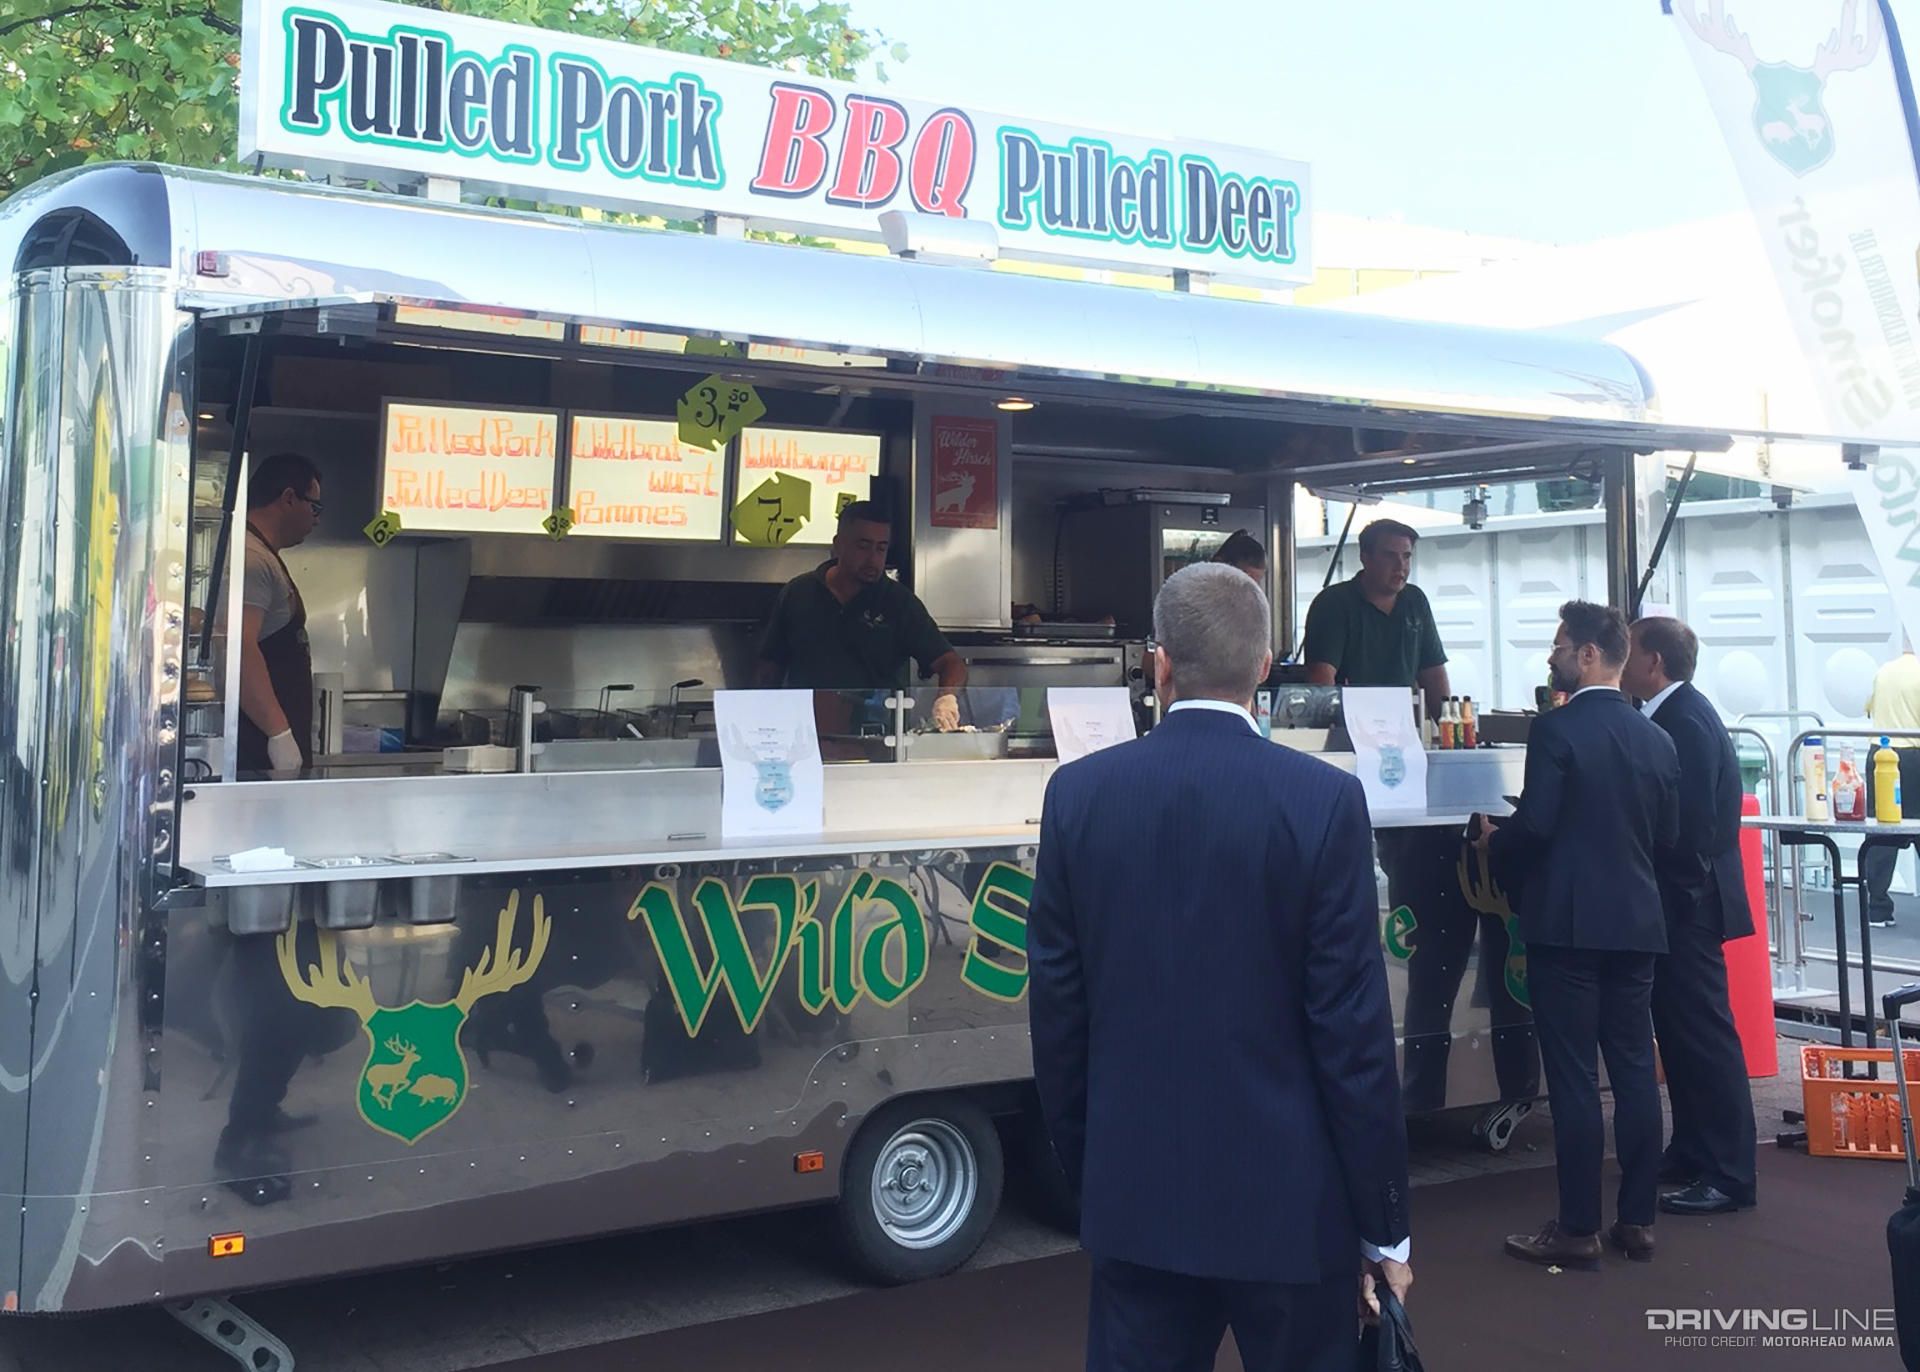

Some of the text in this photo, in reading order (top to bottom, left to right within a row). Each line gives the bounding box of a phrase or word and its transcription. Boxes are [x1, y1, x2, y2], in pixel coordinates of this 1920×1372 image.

[286, 12, 1297, 260] Pulled Pork BBQ Pulled Deer
[744, 435, 875, 484] Wildburger
[952, 447, 991, 466] Hirsch
[574, 490, 688, 527] Pommes
[627, 871, 930, 1038] Wild
